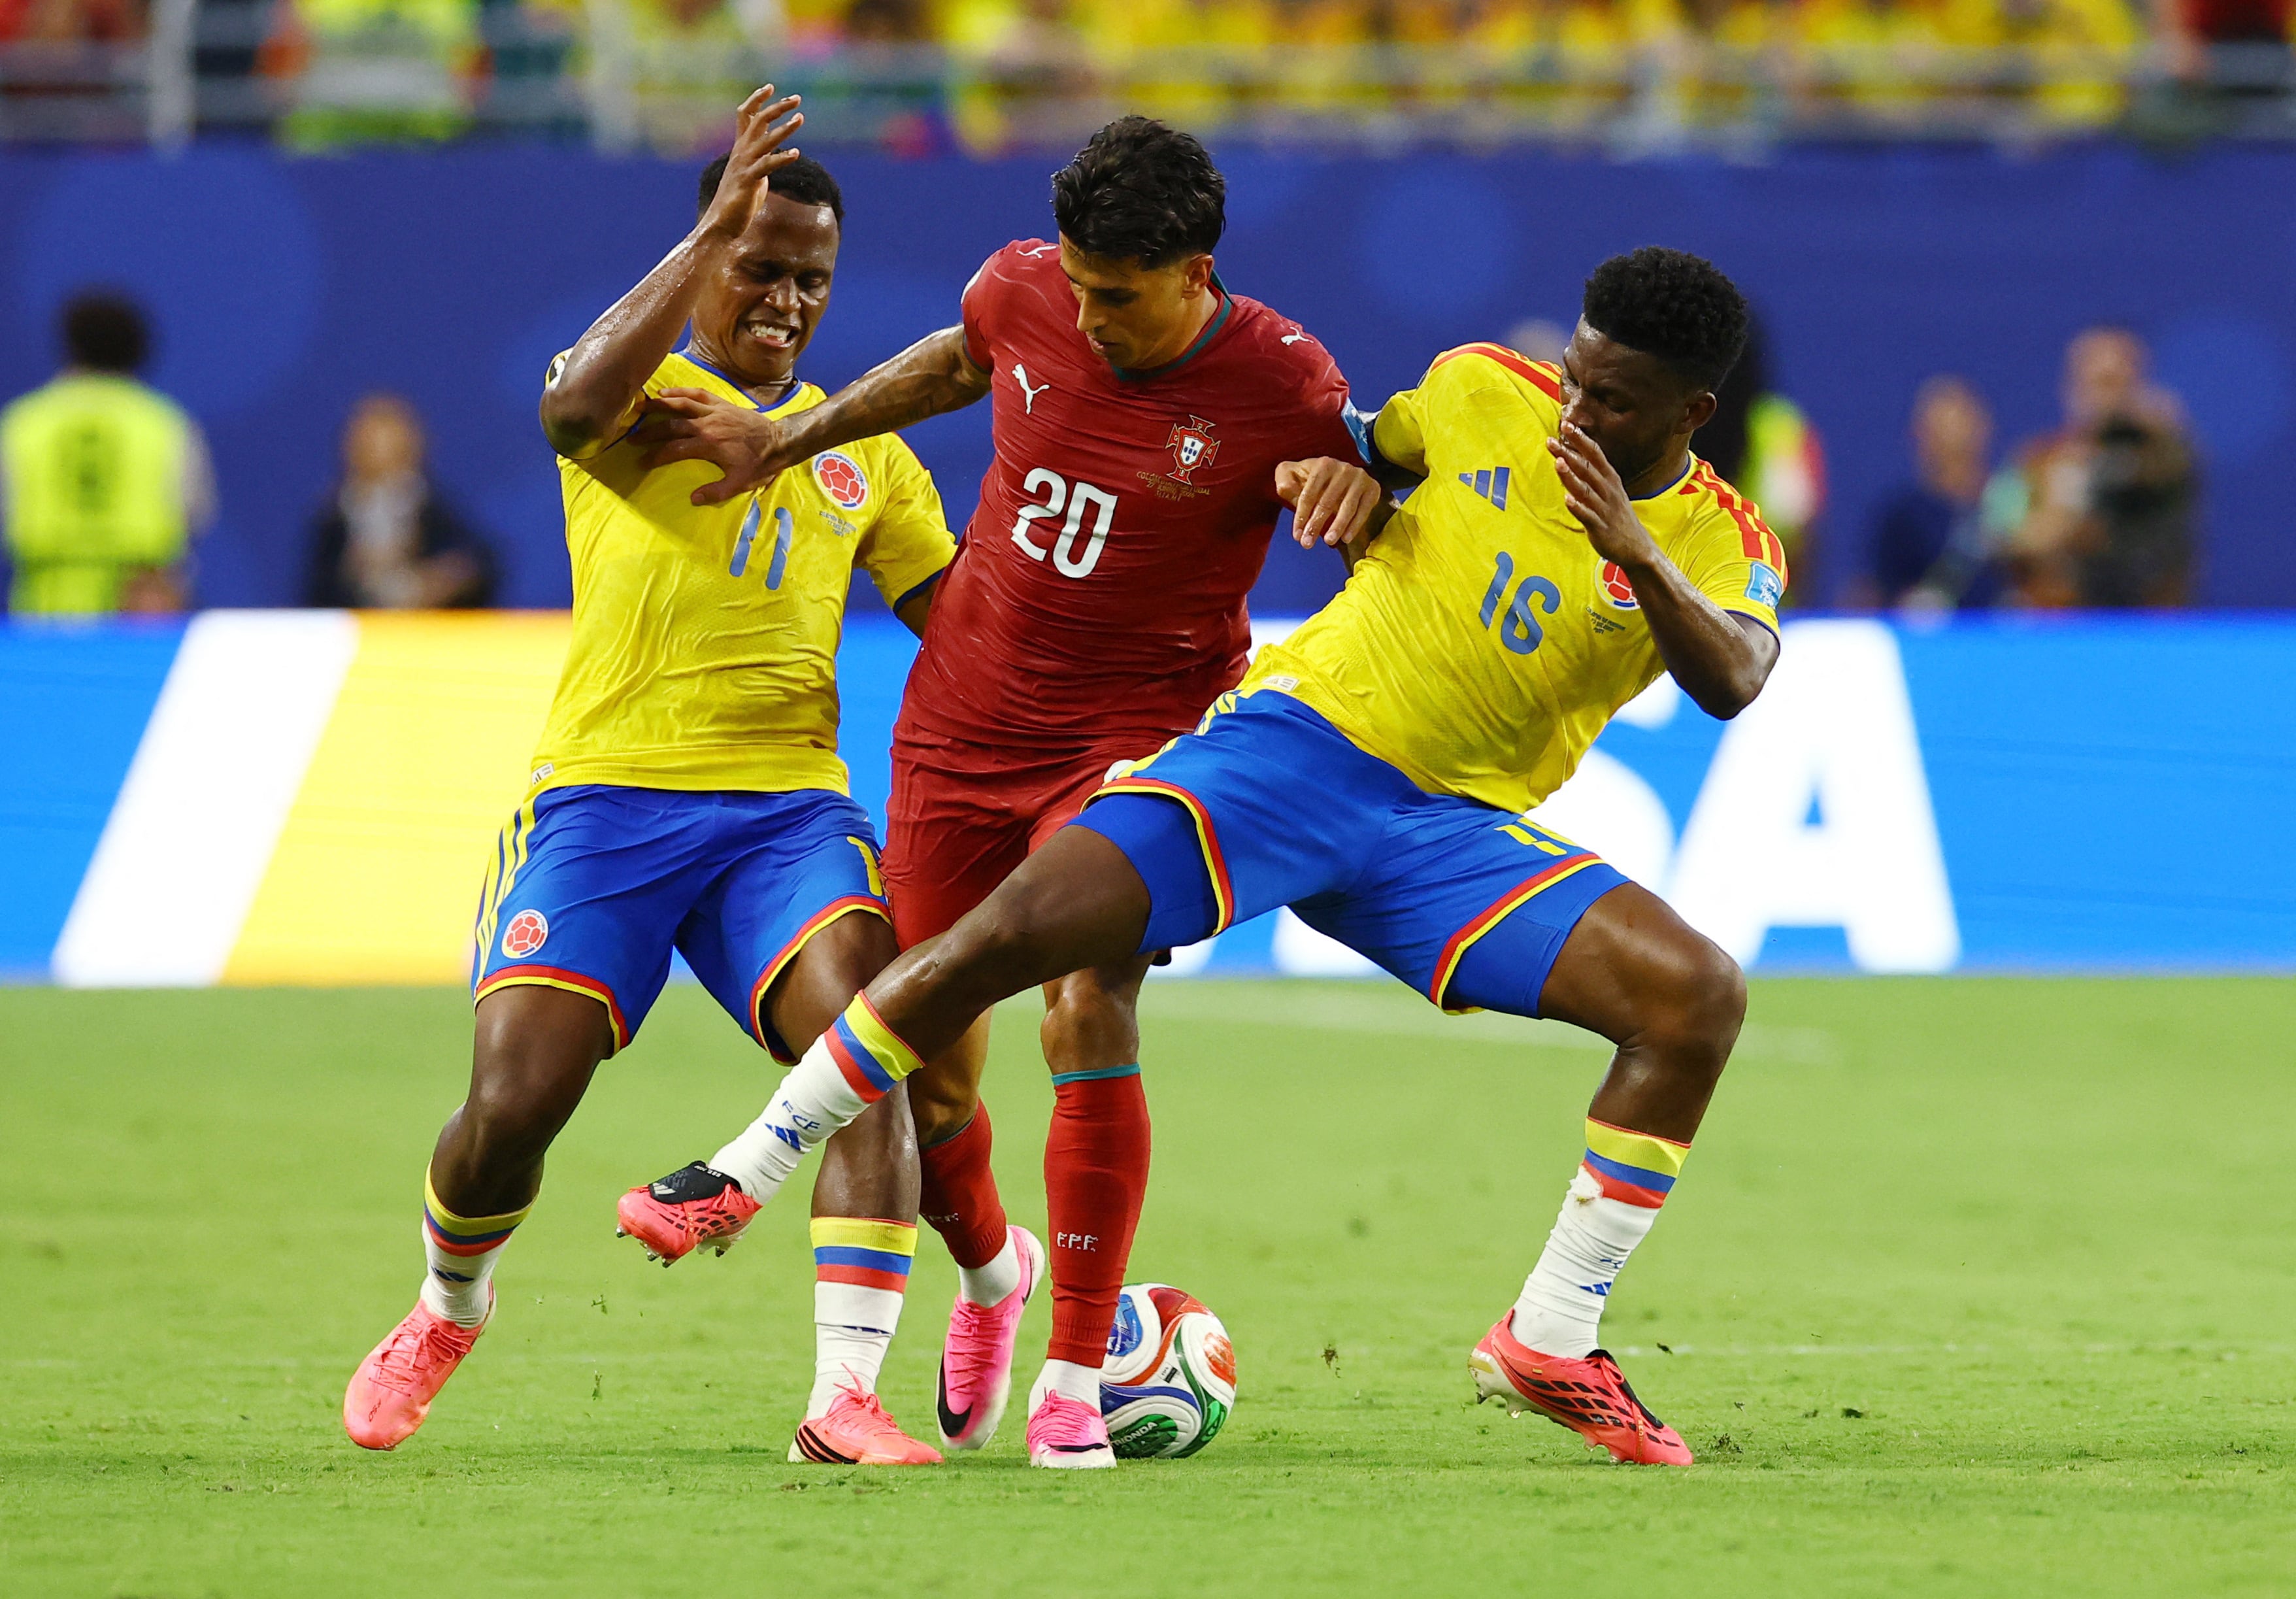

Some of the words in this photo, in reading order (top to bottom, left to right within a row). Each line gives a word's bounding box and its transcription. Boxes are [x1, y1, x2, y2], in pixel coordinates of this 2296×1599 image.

[729, 497, 793, 590] 11
[1011, 467, 1118, 579] 20
[1478, 551, 1561, 655] 16
[782, 1100, 821, 1130] FCF
[1057, 1232, 1099, 1253] F.P.F.
